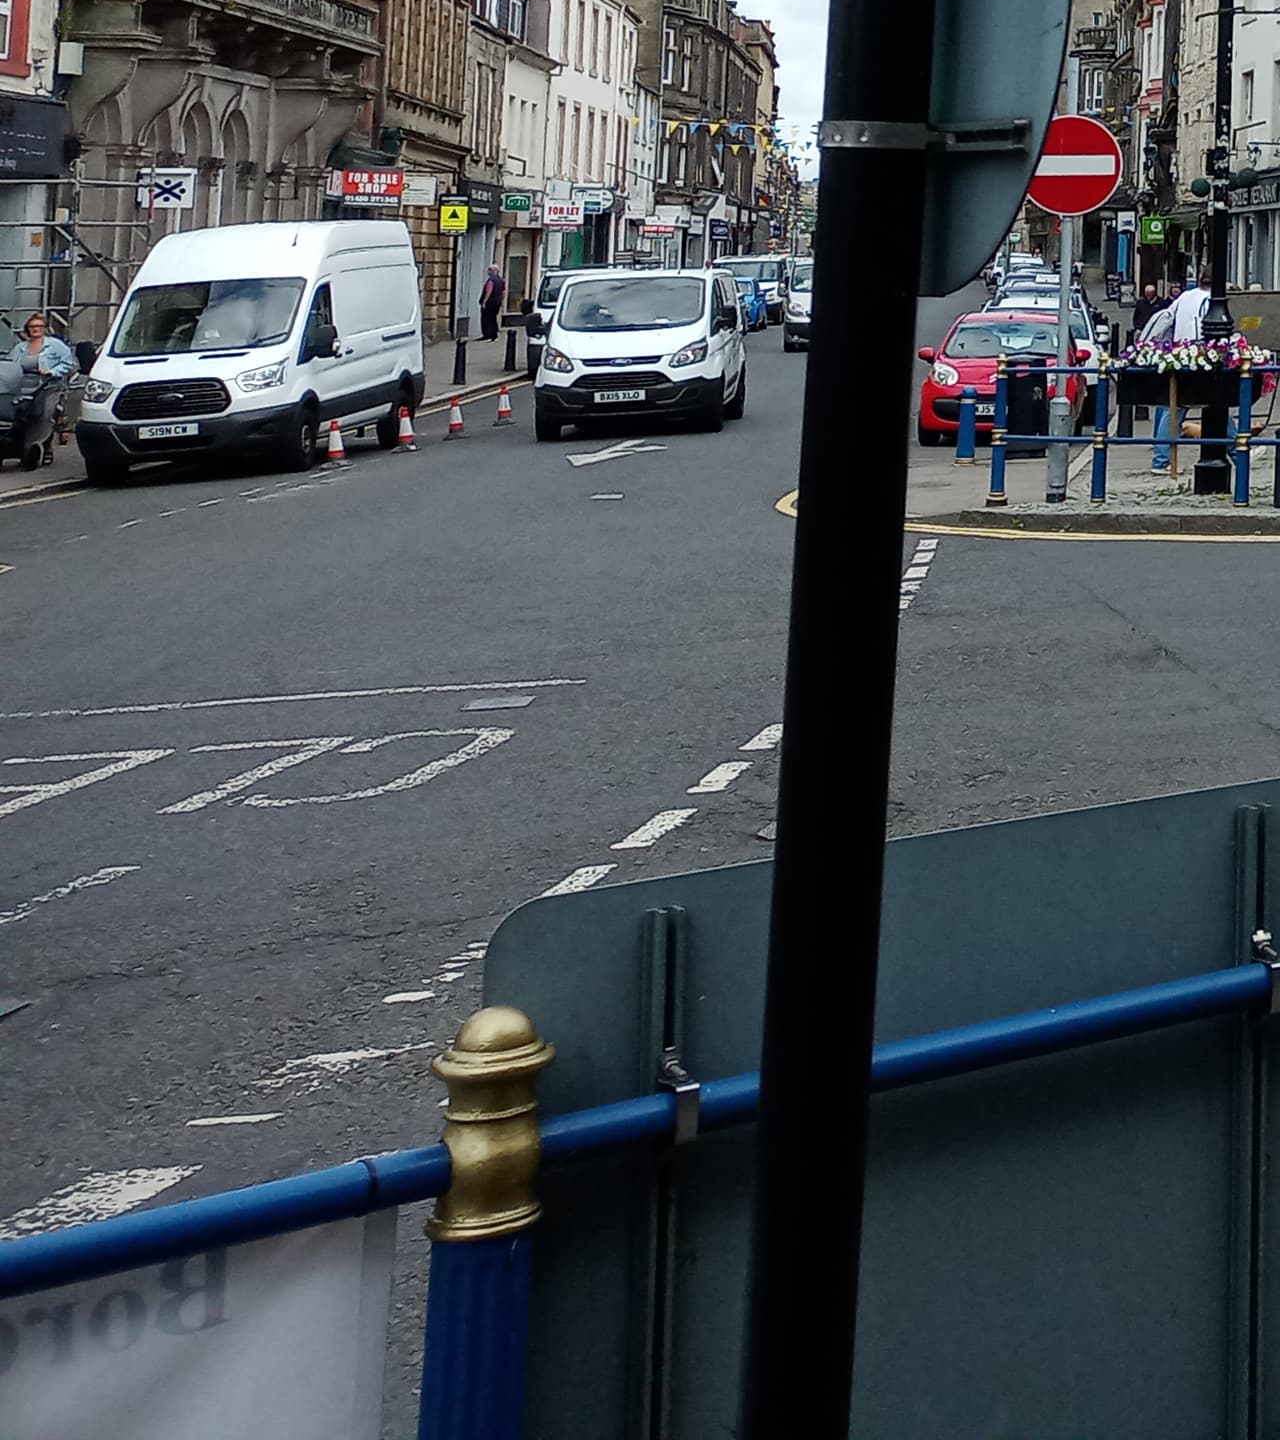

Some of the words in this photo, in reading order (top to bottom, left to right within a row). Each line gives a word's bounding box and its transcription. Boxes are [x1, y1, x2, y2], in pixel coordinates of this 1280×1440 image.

[348, 172, 369, 184] FOR
[372, 173, 399, 185] SALE
[357, 183, 388, 194] SHOP
[548, 206, 565, 216] FOR
[566, 206, 580, 216] LET
